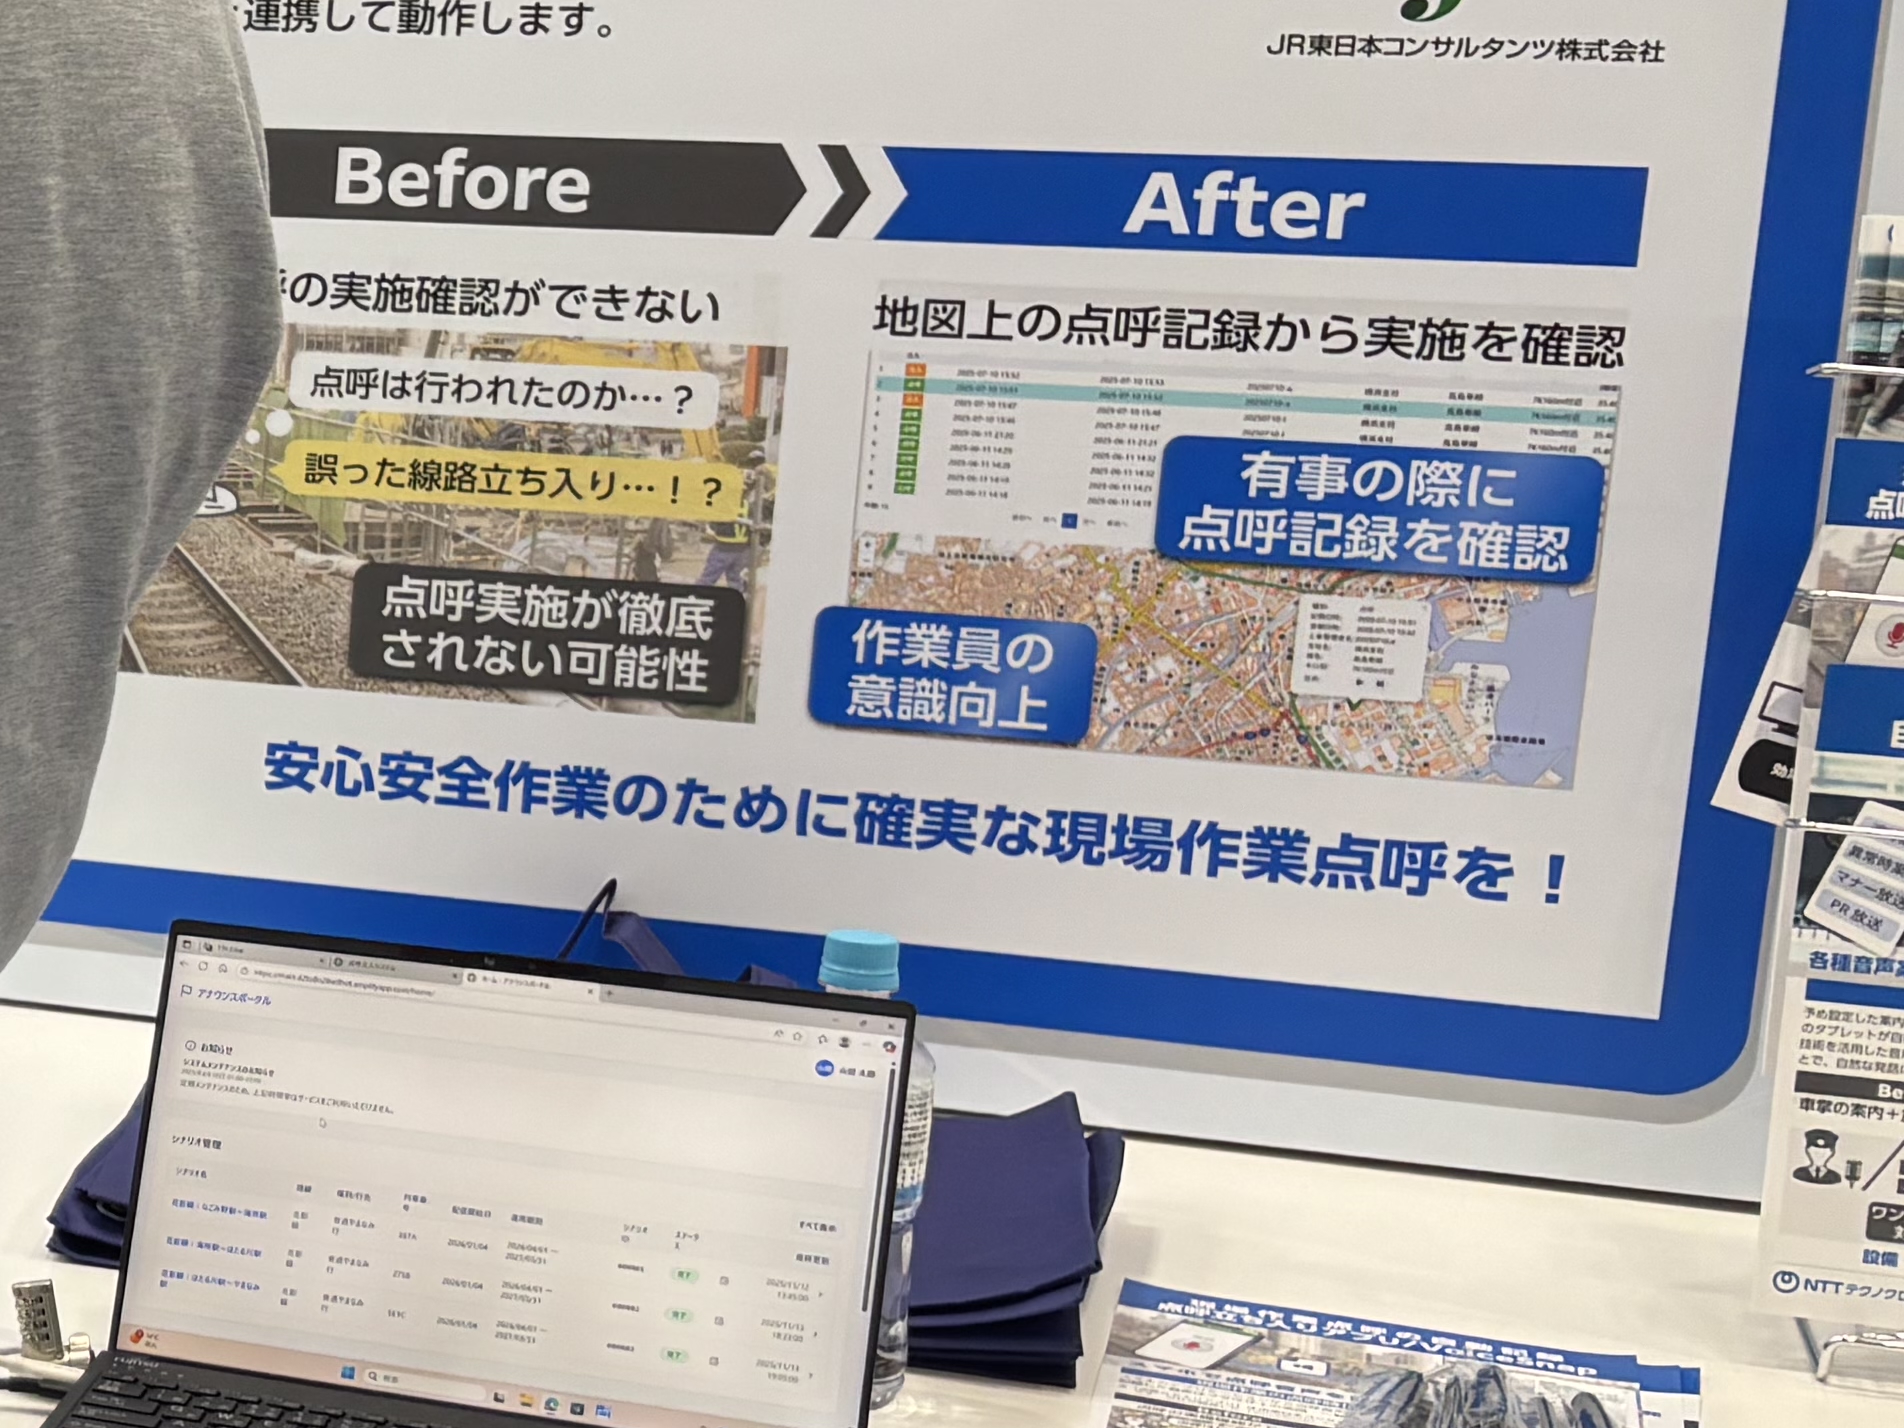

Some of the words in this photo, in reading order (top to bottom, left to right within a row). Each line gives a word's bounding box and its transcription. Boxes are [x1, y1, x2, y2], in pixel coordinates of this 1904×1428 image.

[1266, 33, 1666, 64] JR東日本コンサルタンツ株式会社
[333, 145, 591, 213] Before
[1122, 169, 1367, 241] After
[279, 268, 721, 325] の実施確認ができない
[874, 294, 1627, 371] 地図上の点呼記録から実施を確認
[1239, 448, 1516, 510] 有事の際に
[1177, 503, 1569, 574] 点呼記録を確認
[382, 573, 715, 641] 点呼実施が徹底
[382, 627, 709, 694] されない可能性
[851, 617, 1055, 675] 作業員の
[846, 671, 1048, 735] 意識向上
[262, 740, 1571, 908] 安心安全作業のために確実な現場作業点呼を！
